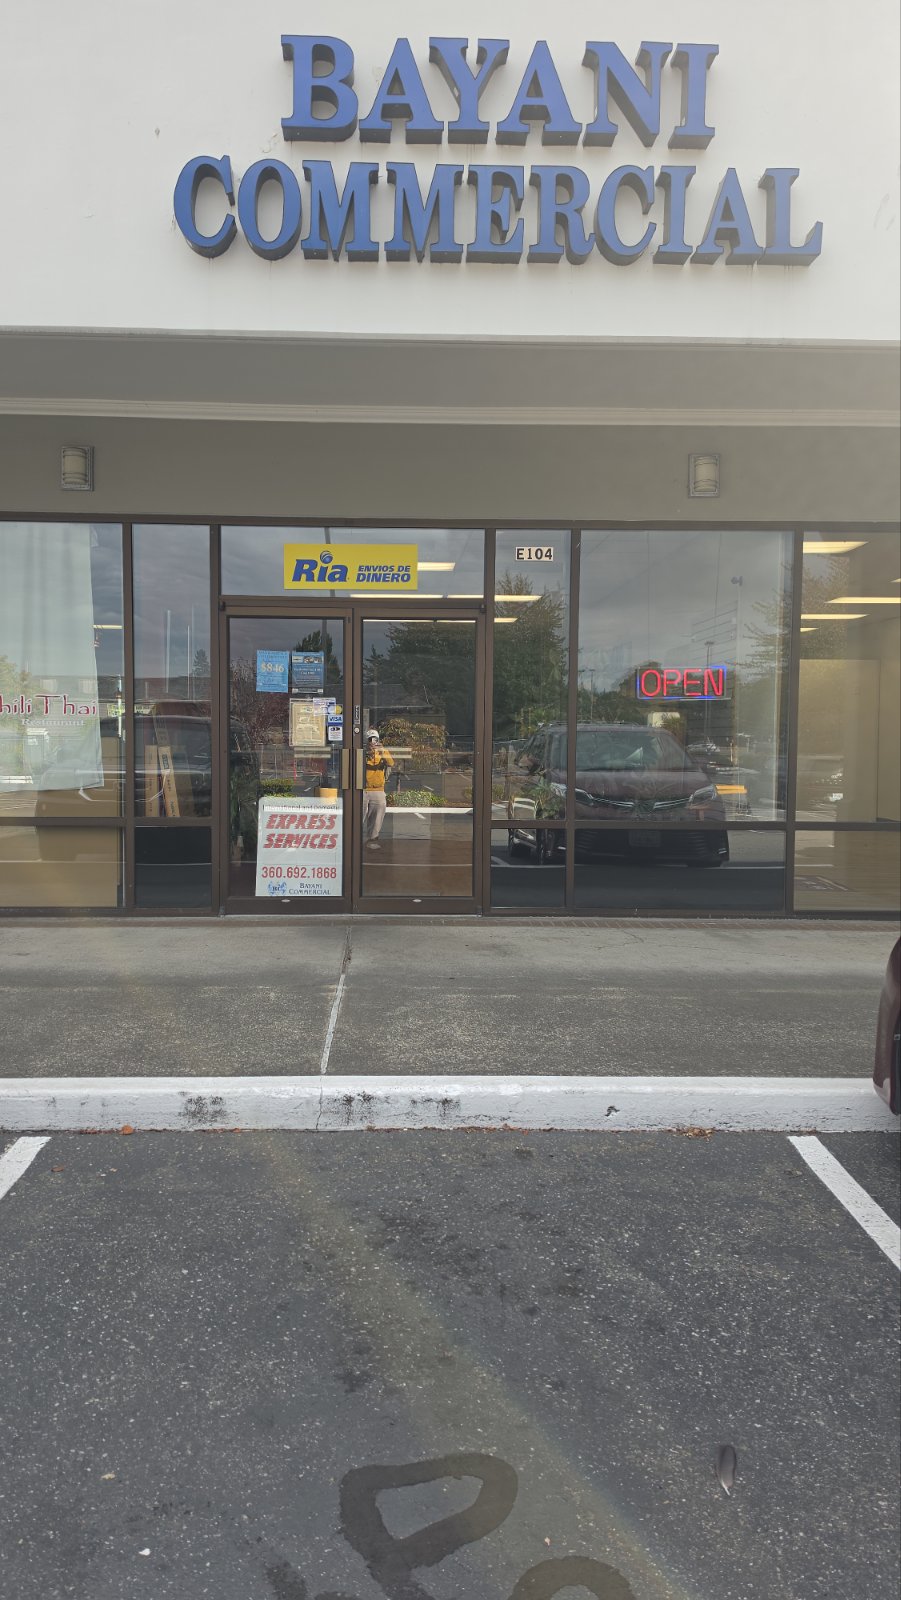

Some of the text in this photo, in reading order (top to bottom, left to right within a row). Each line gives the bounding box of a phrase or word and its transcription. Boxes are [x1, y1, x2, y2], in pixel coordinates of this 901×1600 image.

[280, 34, 720, 149] BAYANI
[173, 154, 823, 266] COMMERCIAL
[516, 547, 553, 561] E104
[292, 550, 348, 582] Ria
[358, 565, 411, 573] ENVIOS DE
[356, 573, 411, 583] DINERO
[640, 668, 723, 697] OPEN
[35, 694, 97, 716] Thai
[265, 814, 337, 829] EXPRESS
[263, 833, 338, 849] SERVICES
[261, 867, 337, 879] 360.692.1868
